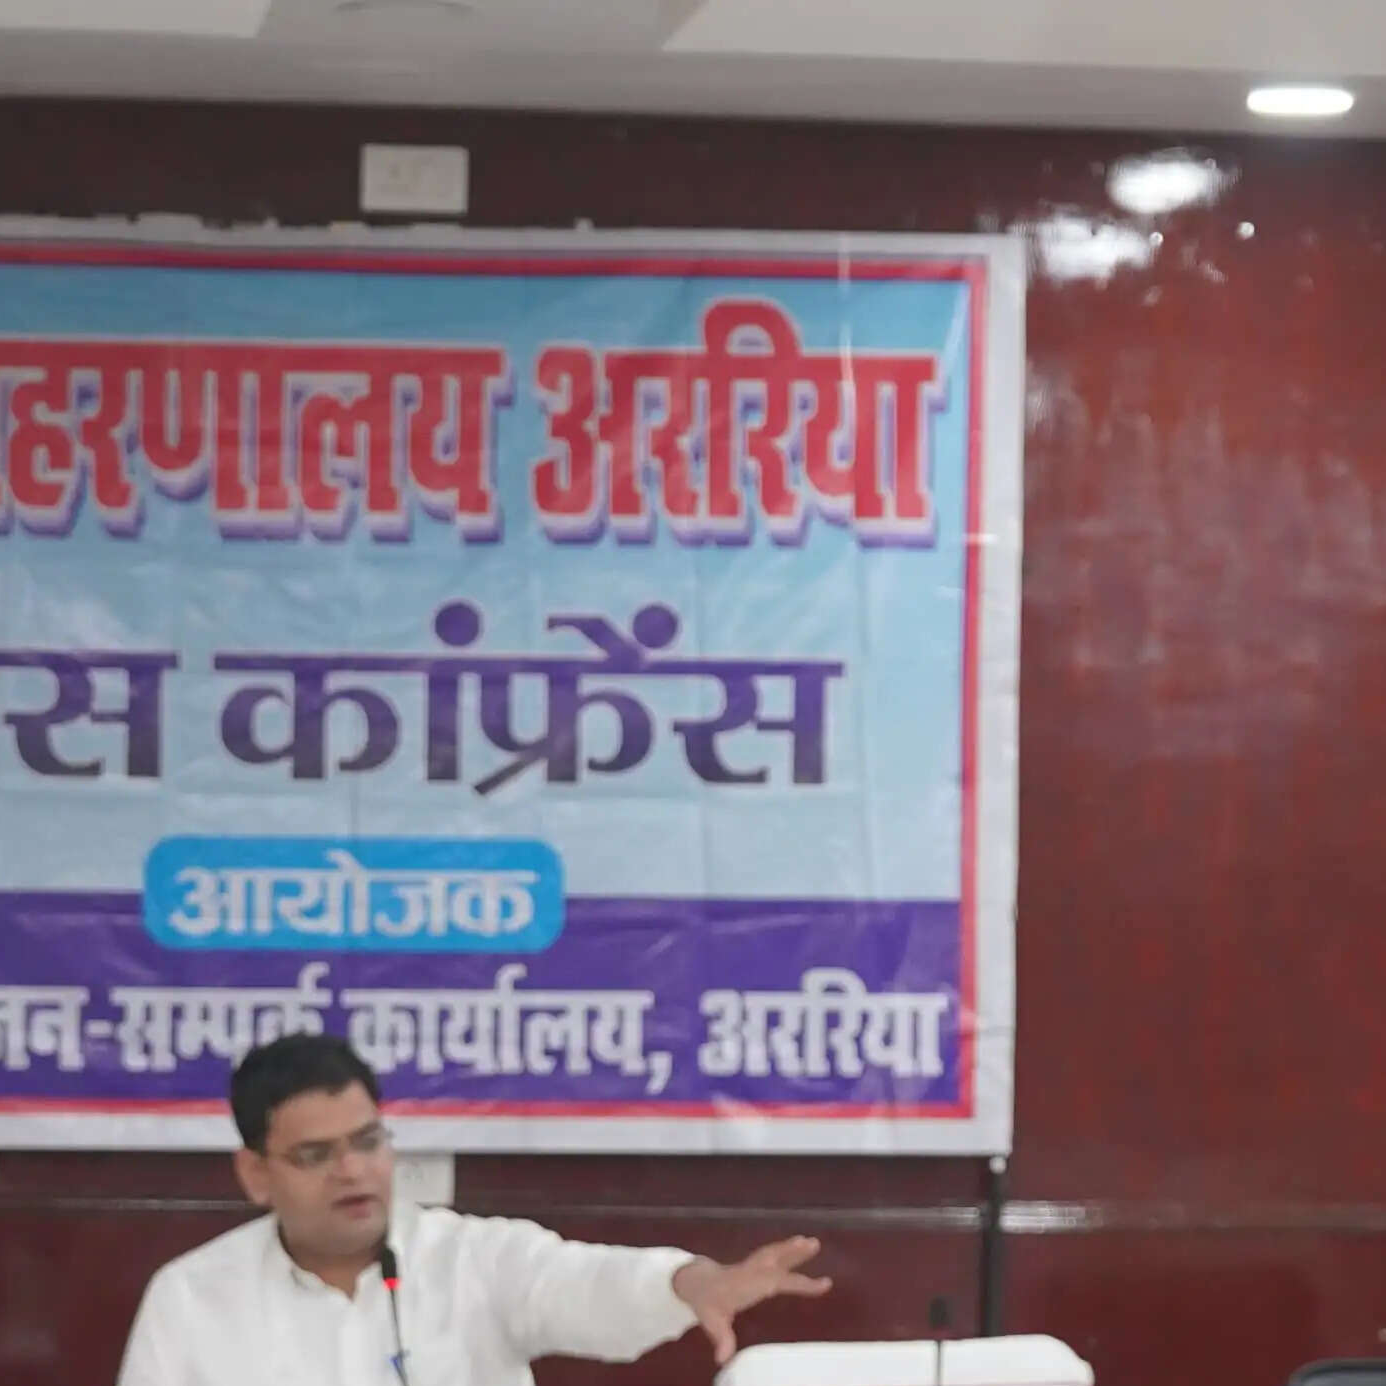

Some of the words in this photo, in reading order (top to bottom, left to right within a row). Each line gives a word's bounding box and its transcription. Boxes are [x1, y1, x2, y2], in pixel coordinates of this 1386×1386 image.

[534, 297, 947, 549] अररिया
[213, 601, 844, 797] कांफ्रेंस
[167, 850, 538, 940] आयोजक
[341, 963, 673, 1095] कार्यालय,
[698, 967, 949, 1078] अररिया
